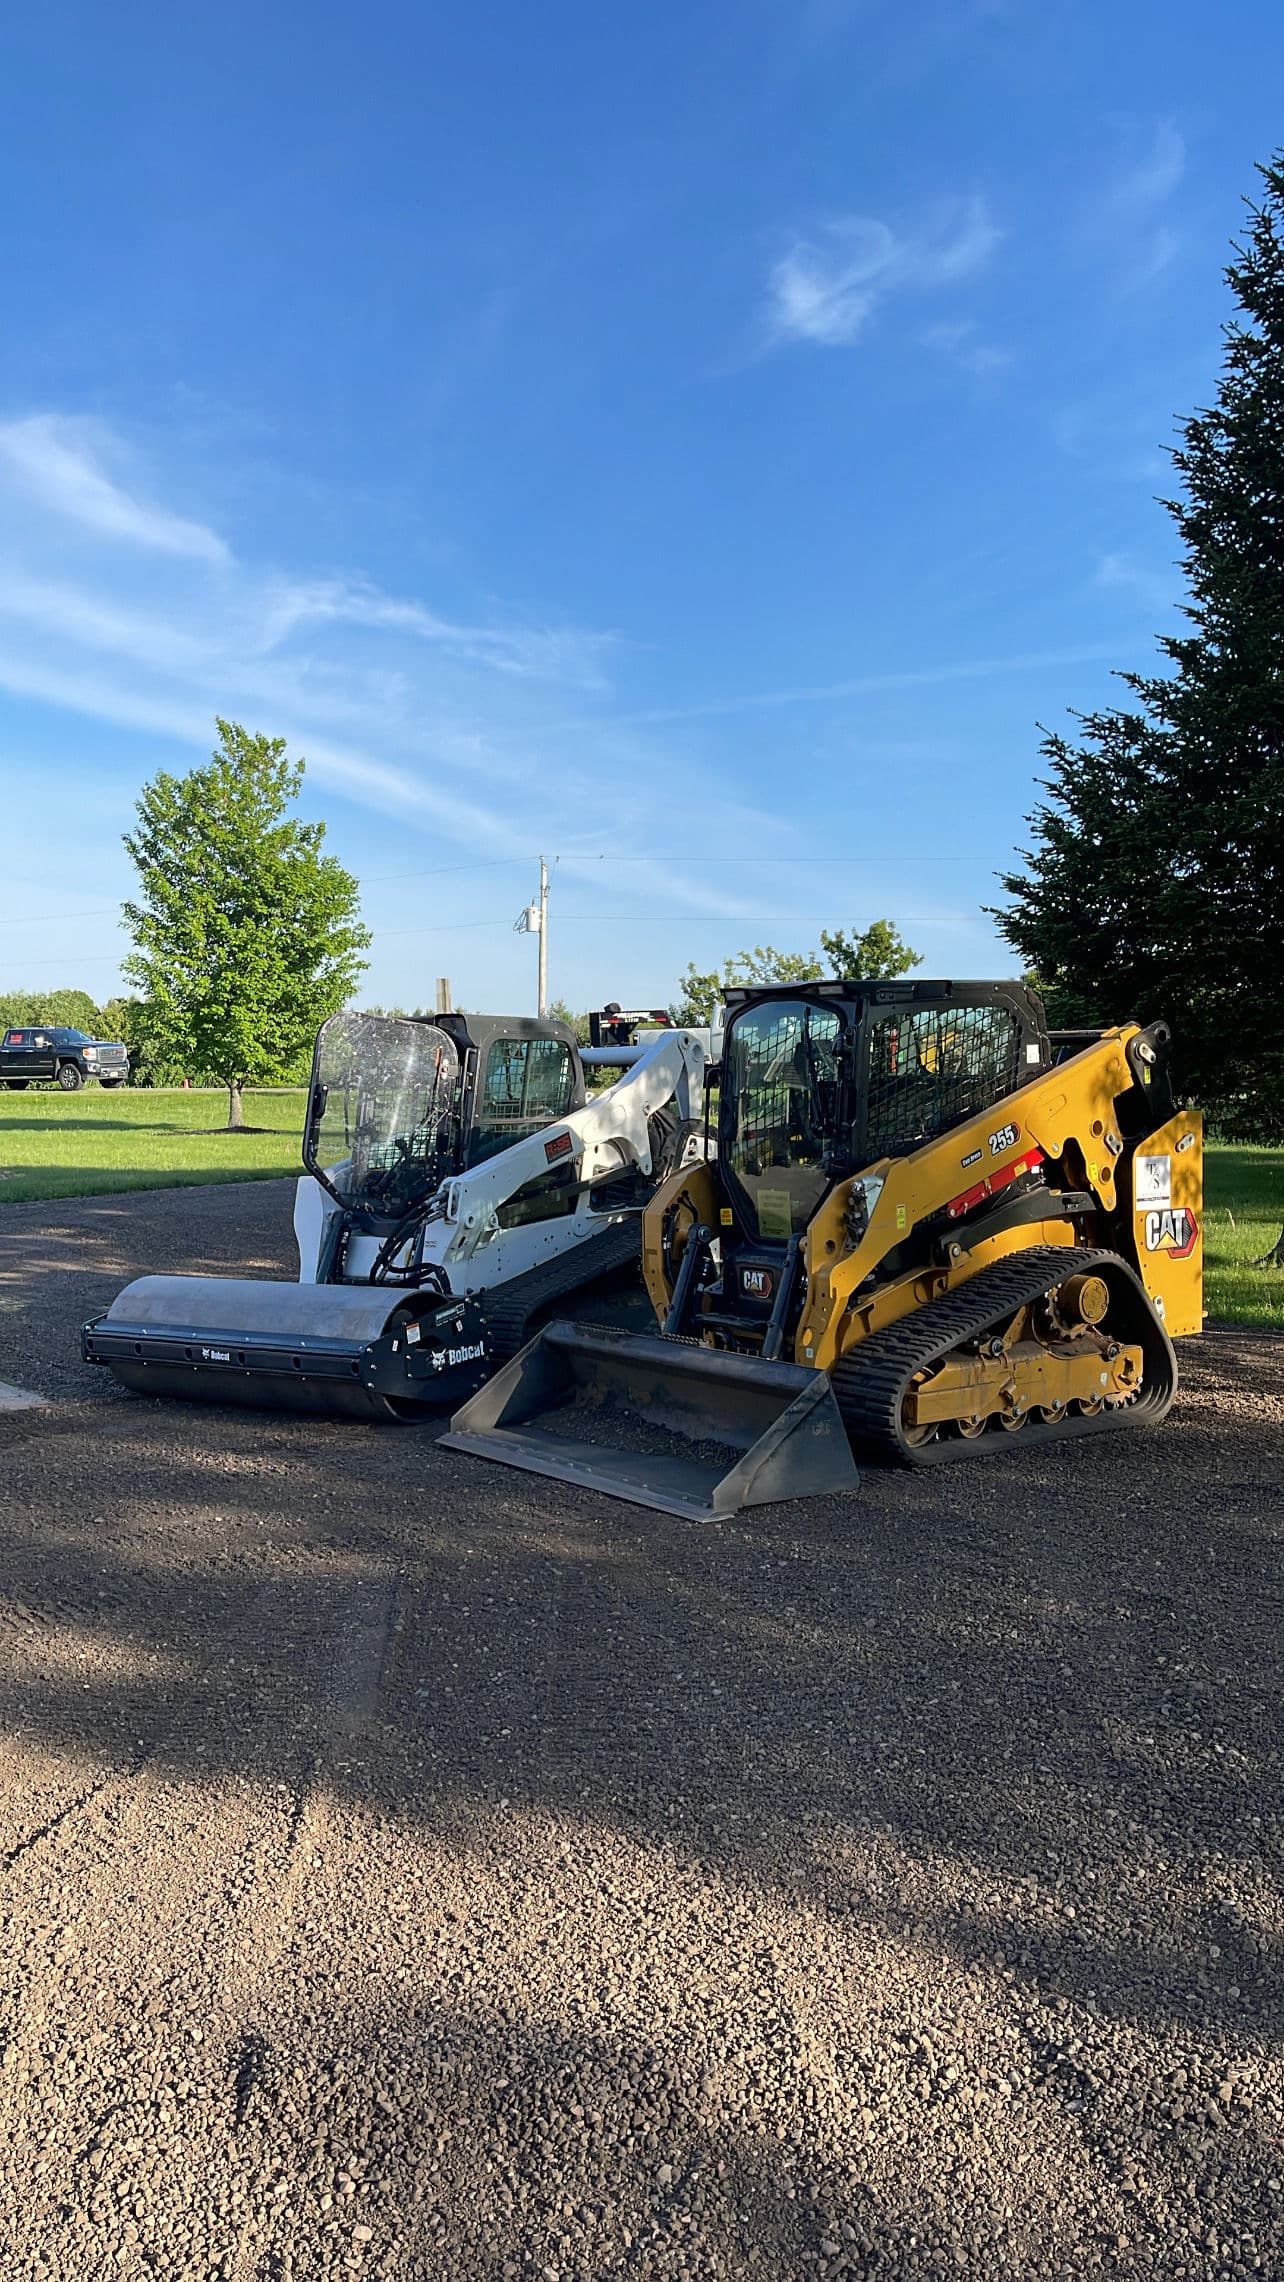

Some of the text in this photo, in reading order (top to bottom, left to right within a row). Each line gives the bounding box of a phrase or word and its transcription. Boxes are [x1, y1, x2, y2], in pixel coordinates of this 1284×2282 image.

[988, 1125, 1015, 1156] 255
[1145, 1209, 1186, 1251] CAT
[743, 1270, 765, 1291] CAT
[210, 1350, 230, 1361] Bobcat
[448, 1340, 485, 1366] Bobcat
